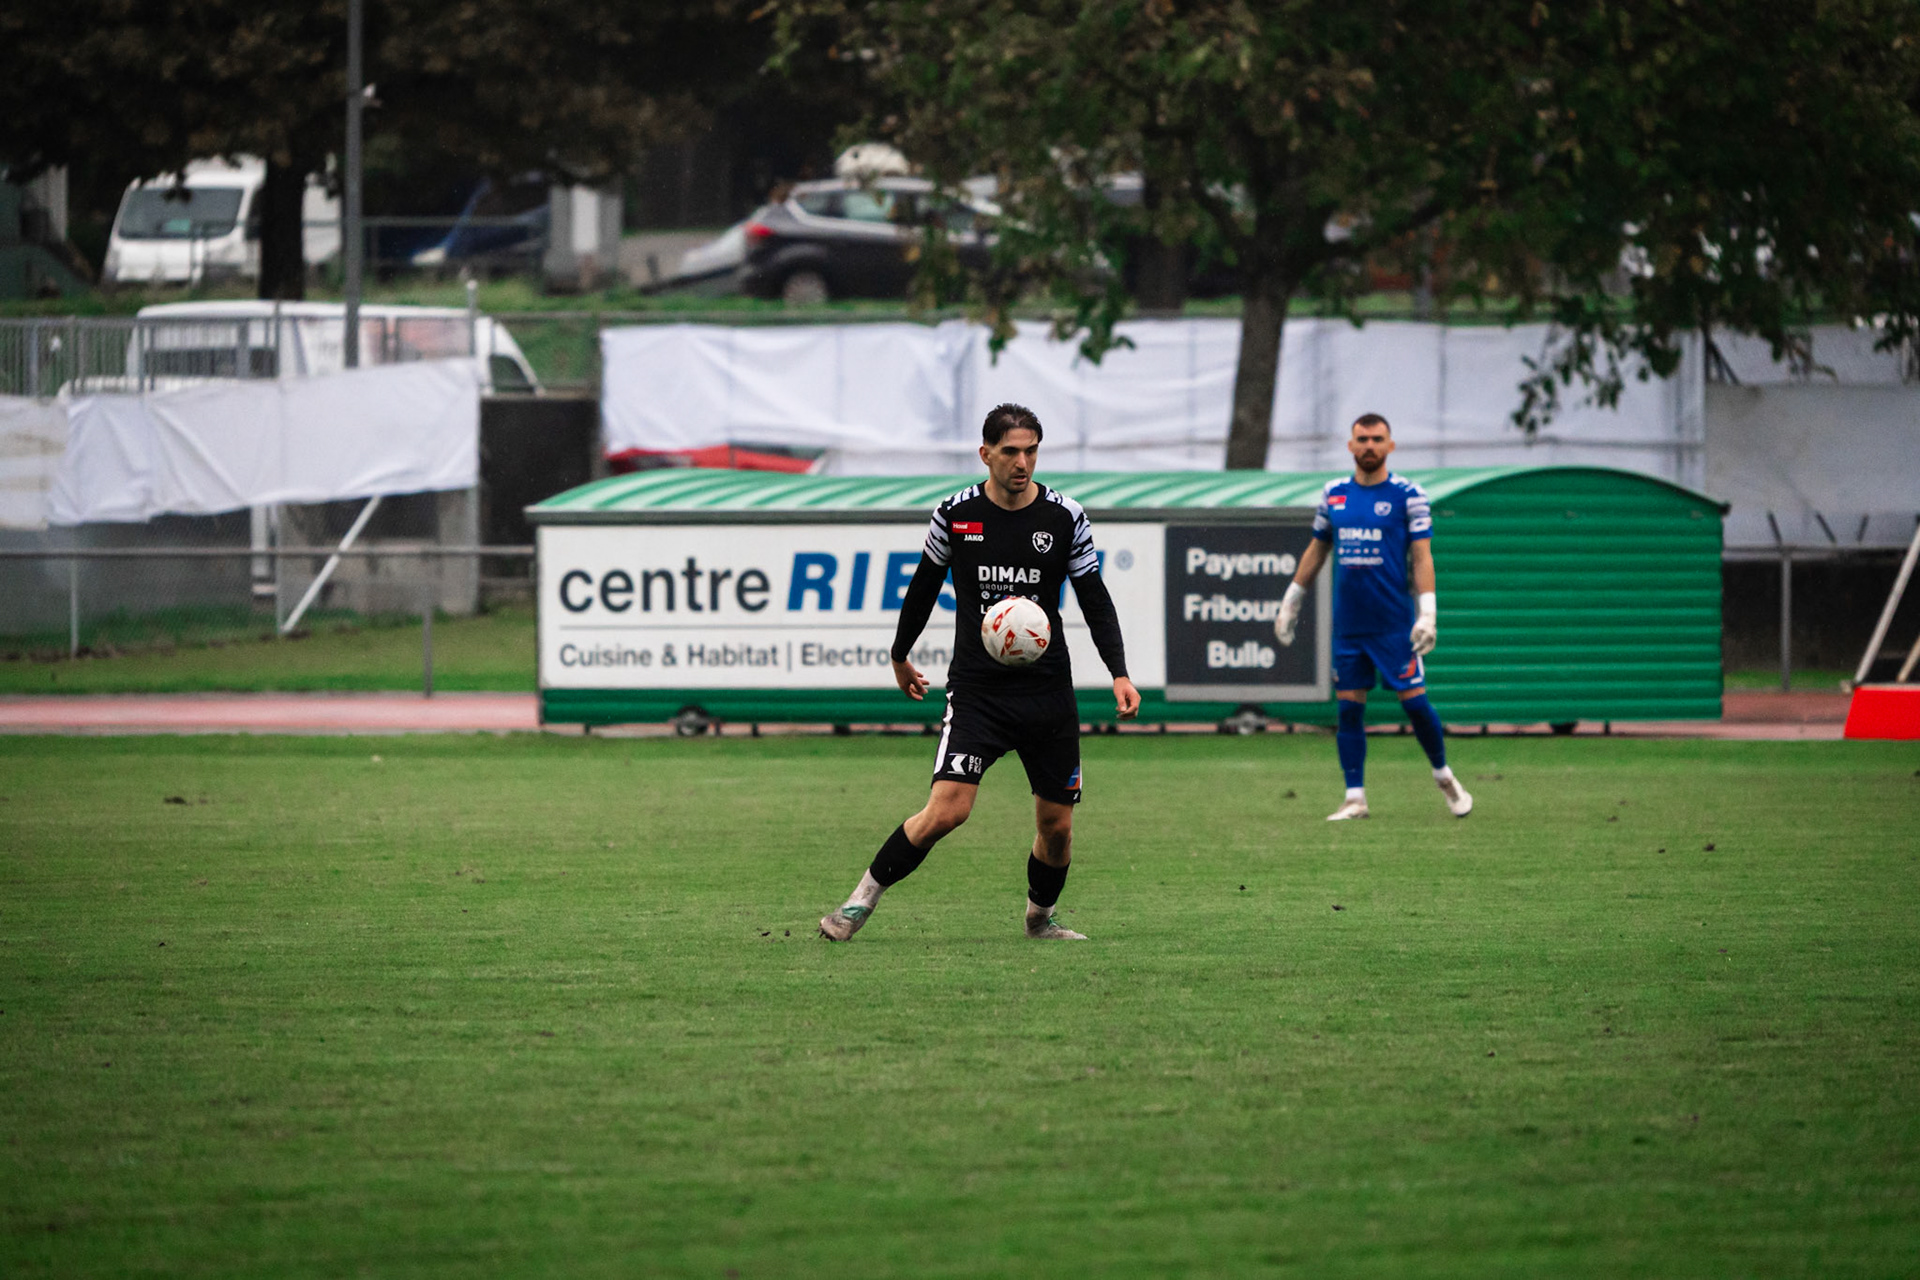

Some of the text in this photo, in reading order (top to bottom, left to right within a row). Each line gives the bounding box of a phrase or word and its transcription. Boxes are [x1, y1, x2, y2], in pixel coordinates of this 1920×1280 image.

[963, 534, 984, 542] JAKO
[978, 565, 1041, 584] DIMAB
[1186, 547, 1297, 580] Payerne
[558, 556, 771, 613] centre
[979, 583, 1014, 592] GROUPE
[1183, 594, 1285, 622] Fribour
[559, 643, 653, 668] Cuisine
[661, 643, 678, 667] &
[686, 643, 779, 667] Habitat
[1207, 640, 1276, 669] Bulle
